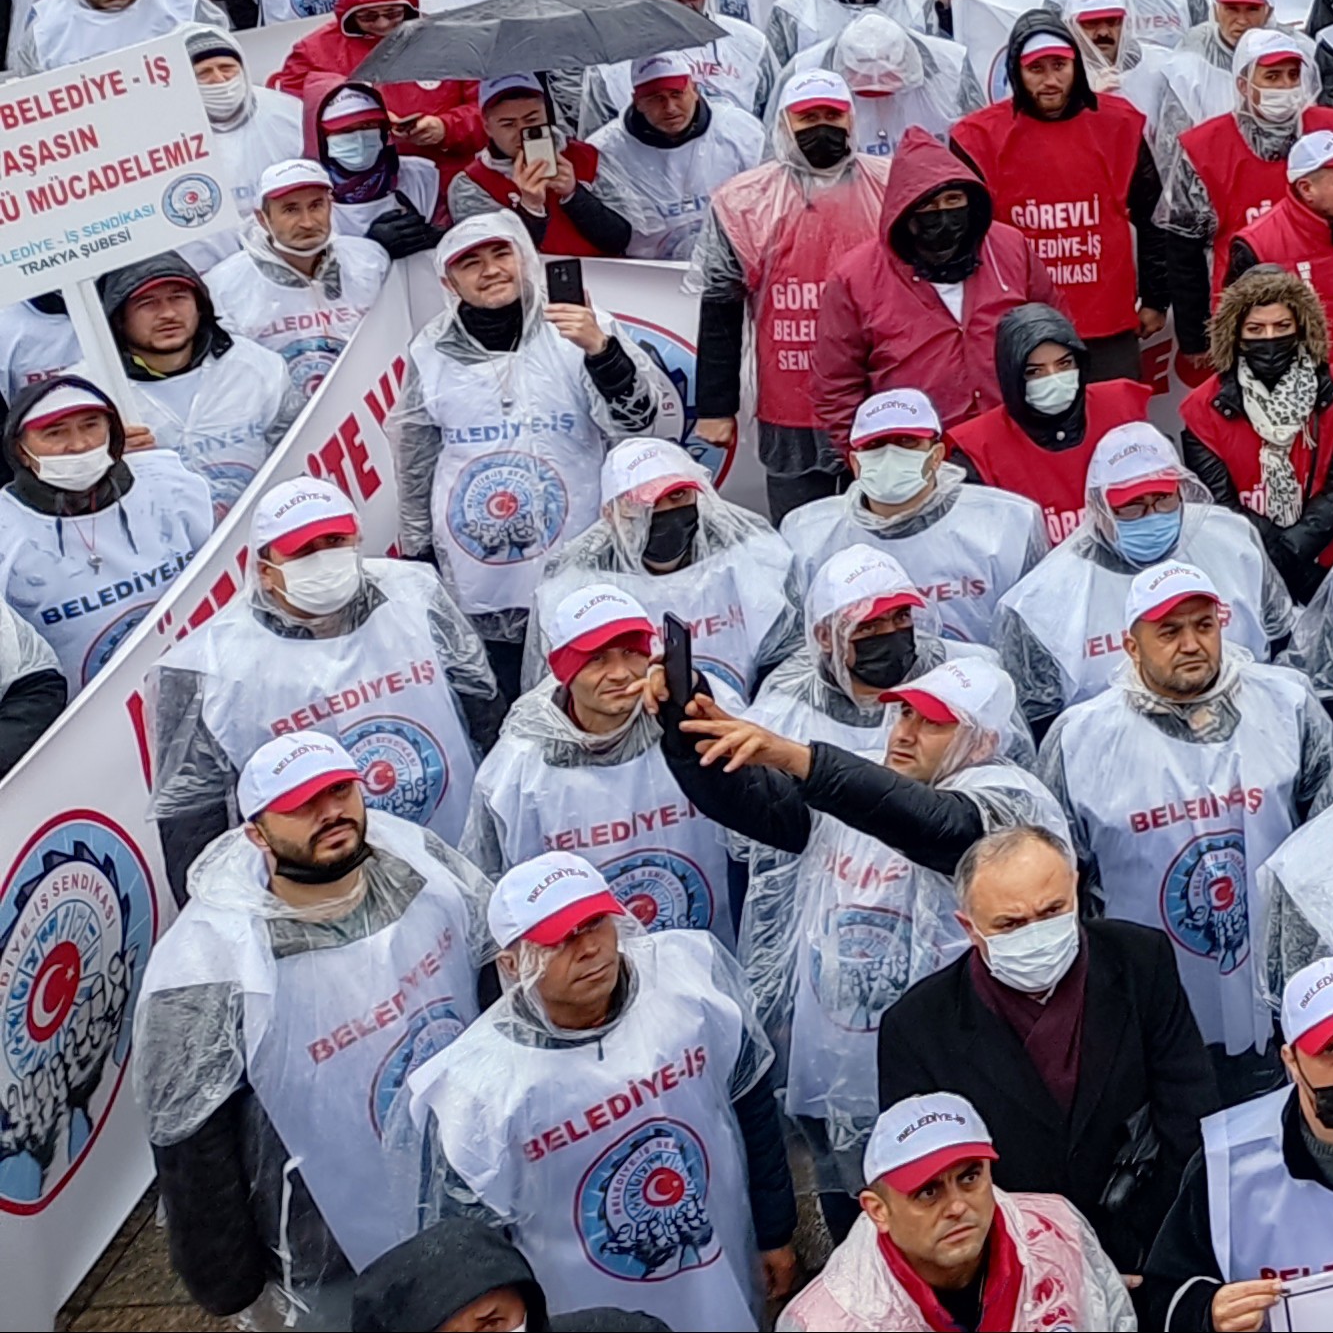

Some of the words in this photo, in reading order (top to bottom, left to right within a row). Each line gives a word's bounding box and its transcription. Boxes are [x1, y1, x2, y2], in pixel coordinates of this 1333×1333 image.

[0, 70, 128, 131] BELEDİYE
[0, 124, 99, 179] AŞASIN
[26, 132, 209, 214] MÜCADELEMİZ
[0, 236, 54, 267] LEDİYE
[83, 203, 156, 237] SENDİKASI
[1011, 198, 1100, 229] GÖREVLİ
[18, 249, 78, 276] TRAKYA
[81, 229, 132, 258] ŞUBESİ
[272, 662, 435, 736] BELEDİYE-İŞ
[524, 1047, 707, 1163] BELEDİYE-İŞ
